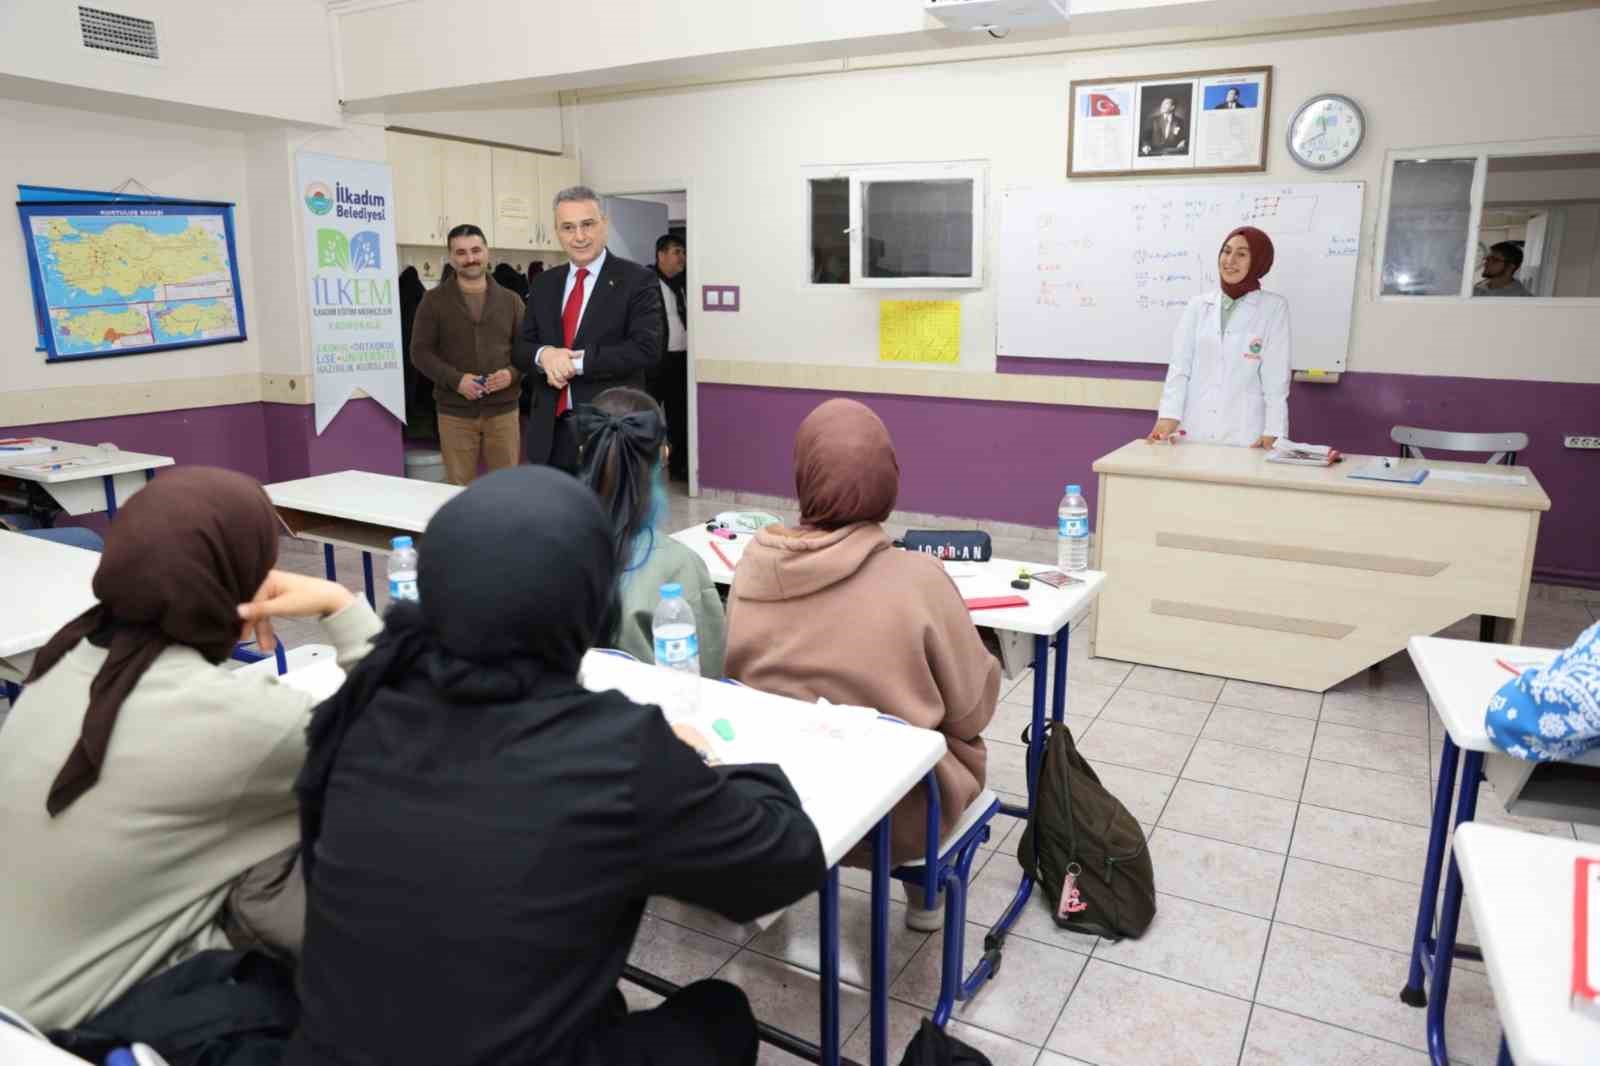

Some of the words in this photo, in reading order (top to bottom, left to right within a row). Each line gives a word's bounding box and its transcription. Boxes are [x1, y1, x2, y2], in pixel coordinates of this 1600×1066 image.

[336, 181, 385, 207] İlkadım
[336, 204, 386, 223] Belediyesi
[312, 275, 392, 305] İLKEM
